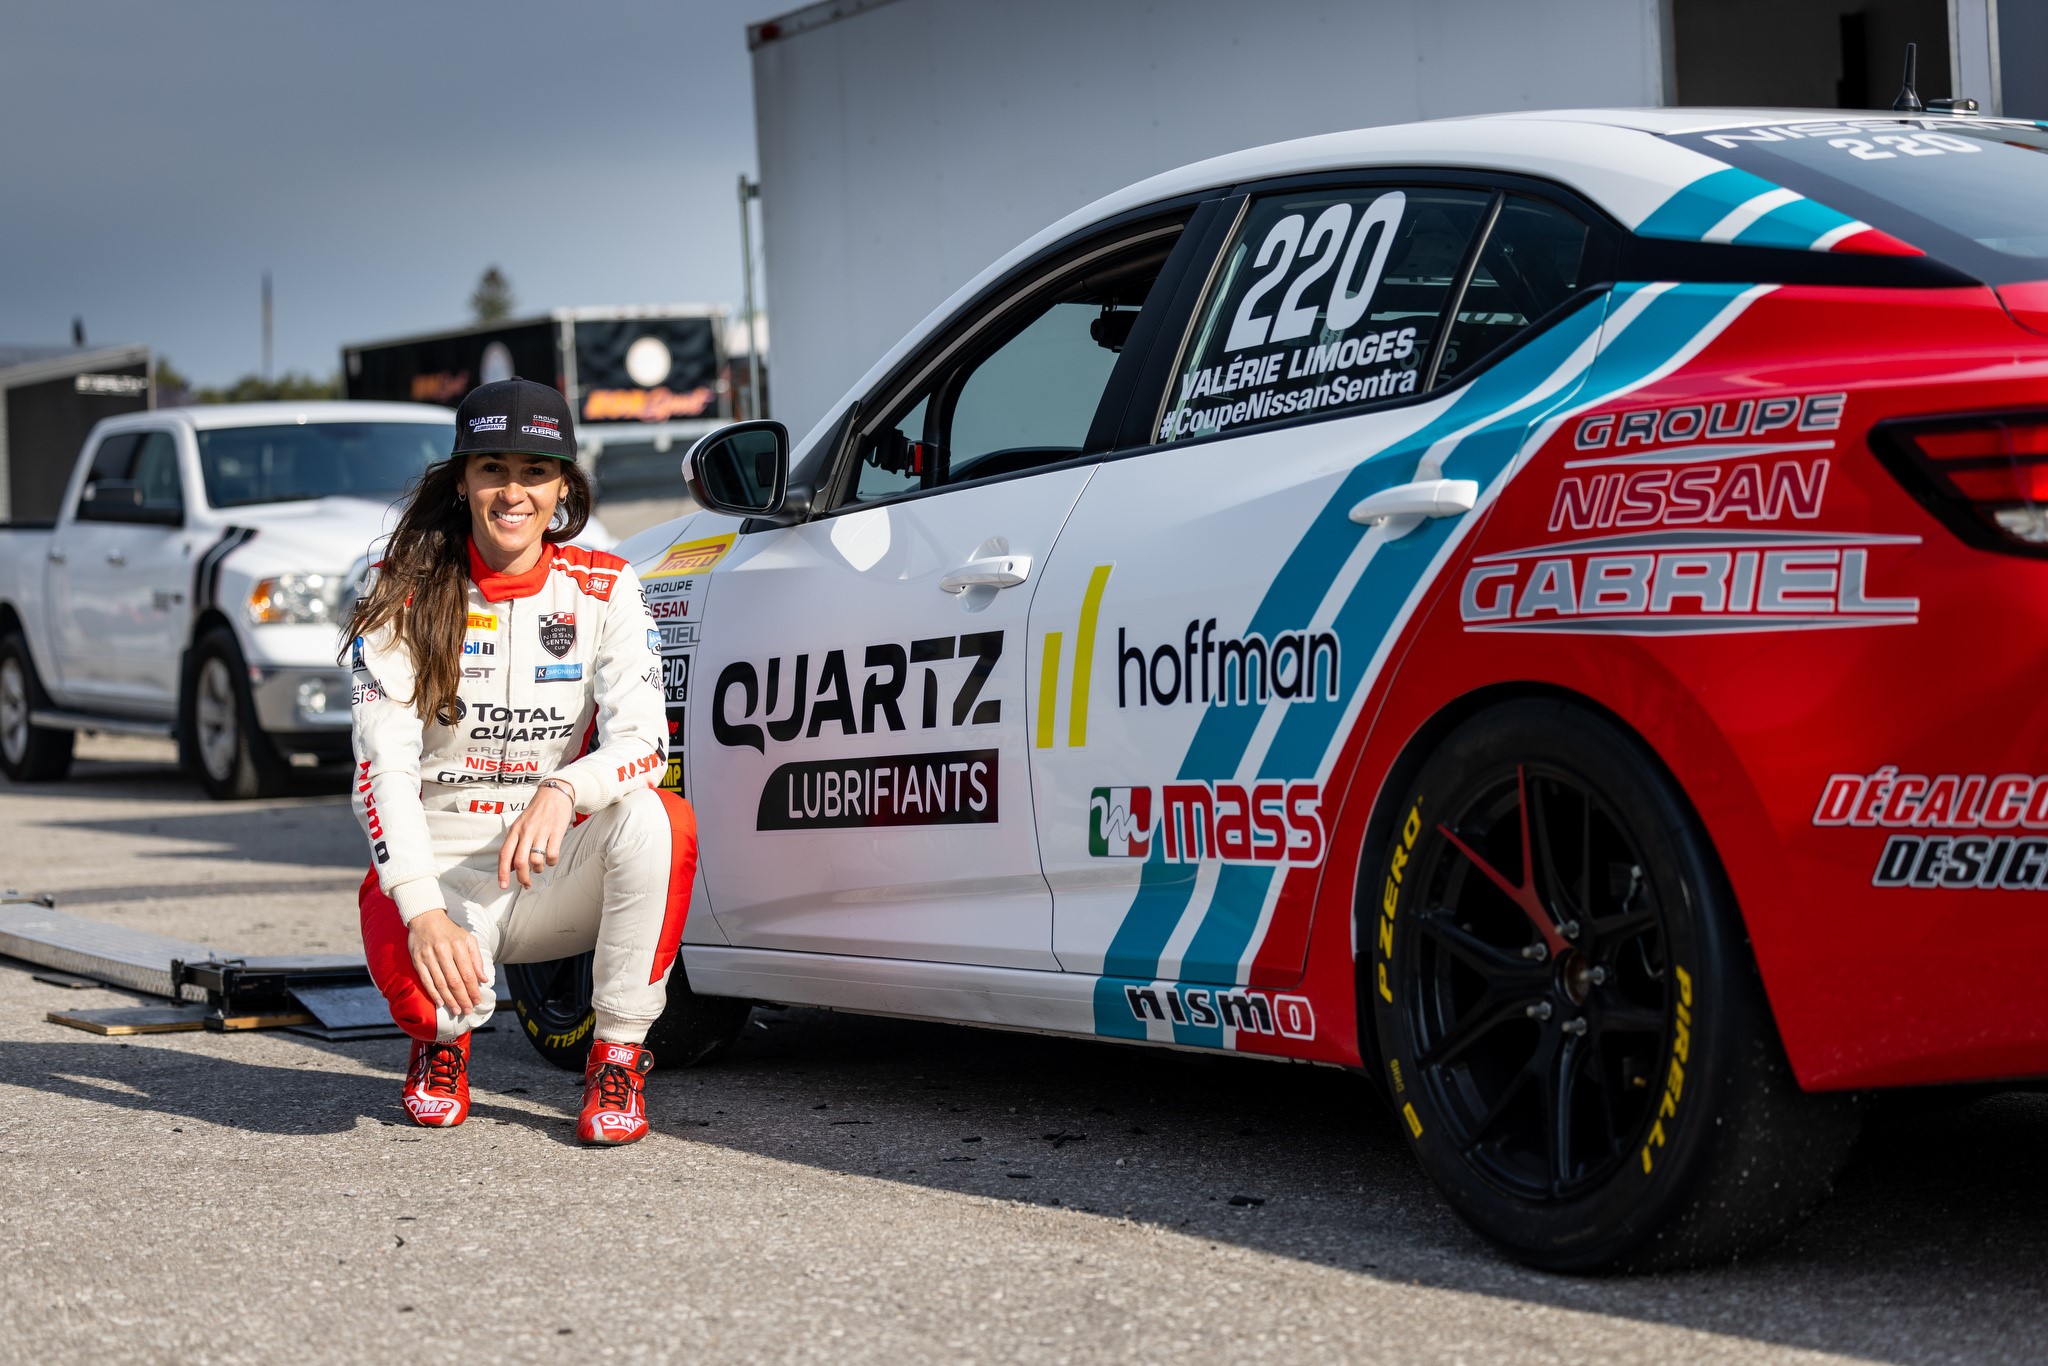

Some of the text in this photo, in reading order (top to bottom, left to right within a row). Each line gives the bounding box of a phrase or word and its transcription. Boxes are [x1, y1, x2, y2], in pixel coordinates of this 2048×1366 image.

[1828, 133, 1983, 160] 220
[1224, 190, 1406, 353] 220
[1180, 327, 1417, 400] VALÉRIE LIMOGES
[1159, 369, 1417, 439] #CoupeNissanSentra
[469, 415, 508, 427] QUARTZ
[521, 425, 562, 439] GABRIEL
[1575, 393, 1847, 451] GROUPE
[1548, 459, 1830, 531] NISSAN
[654, 544, 727, 572] PIRELLI
[585, 579, 609, 590] OMP
[645, 580, 693, 595] GROUPE
[1459, 549, 1920, 622] GABRIEL
[661, 626, 702, 644] RIEL
[1117, 617, 1340, 709] hoffman
[711, 629, 1005, 756] QUARTZ
[472, 703, 565, 724] TOTAL
[470, 723, 575, 743] QUARTZ
[465, 756, 539, 773] NISSAN
[467, 746, 541, 758] GROUPE
[437, 771, 547, 785] GABRIE
[787, 760, 989, 820] LUBRIFIANTS
[1872, 834, 2048, 890] DESIG
[1378, 805, 1422, 1003] P ZERO
[1123, 985, 1316, 1041] nismo
[607, 1049, 634, 1064] OMP
[1640, 964, 1693, 1175] PIRELLI
[409, 1099, 453, 1115] OMP
